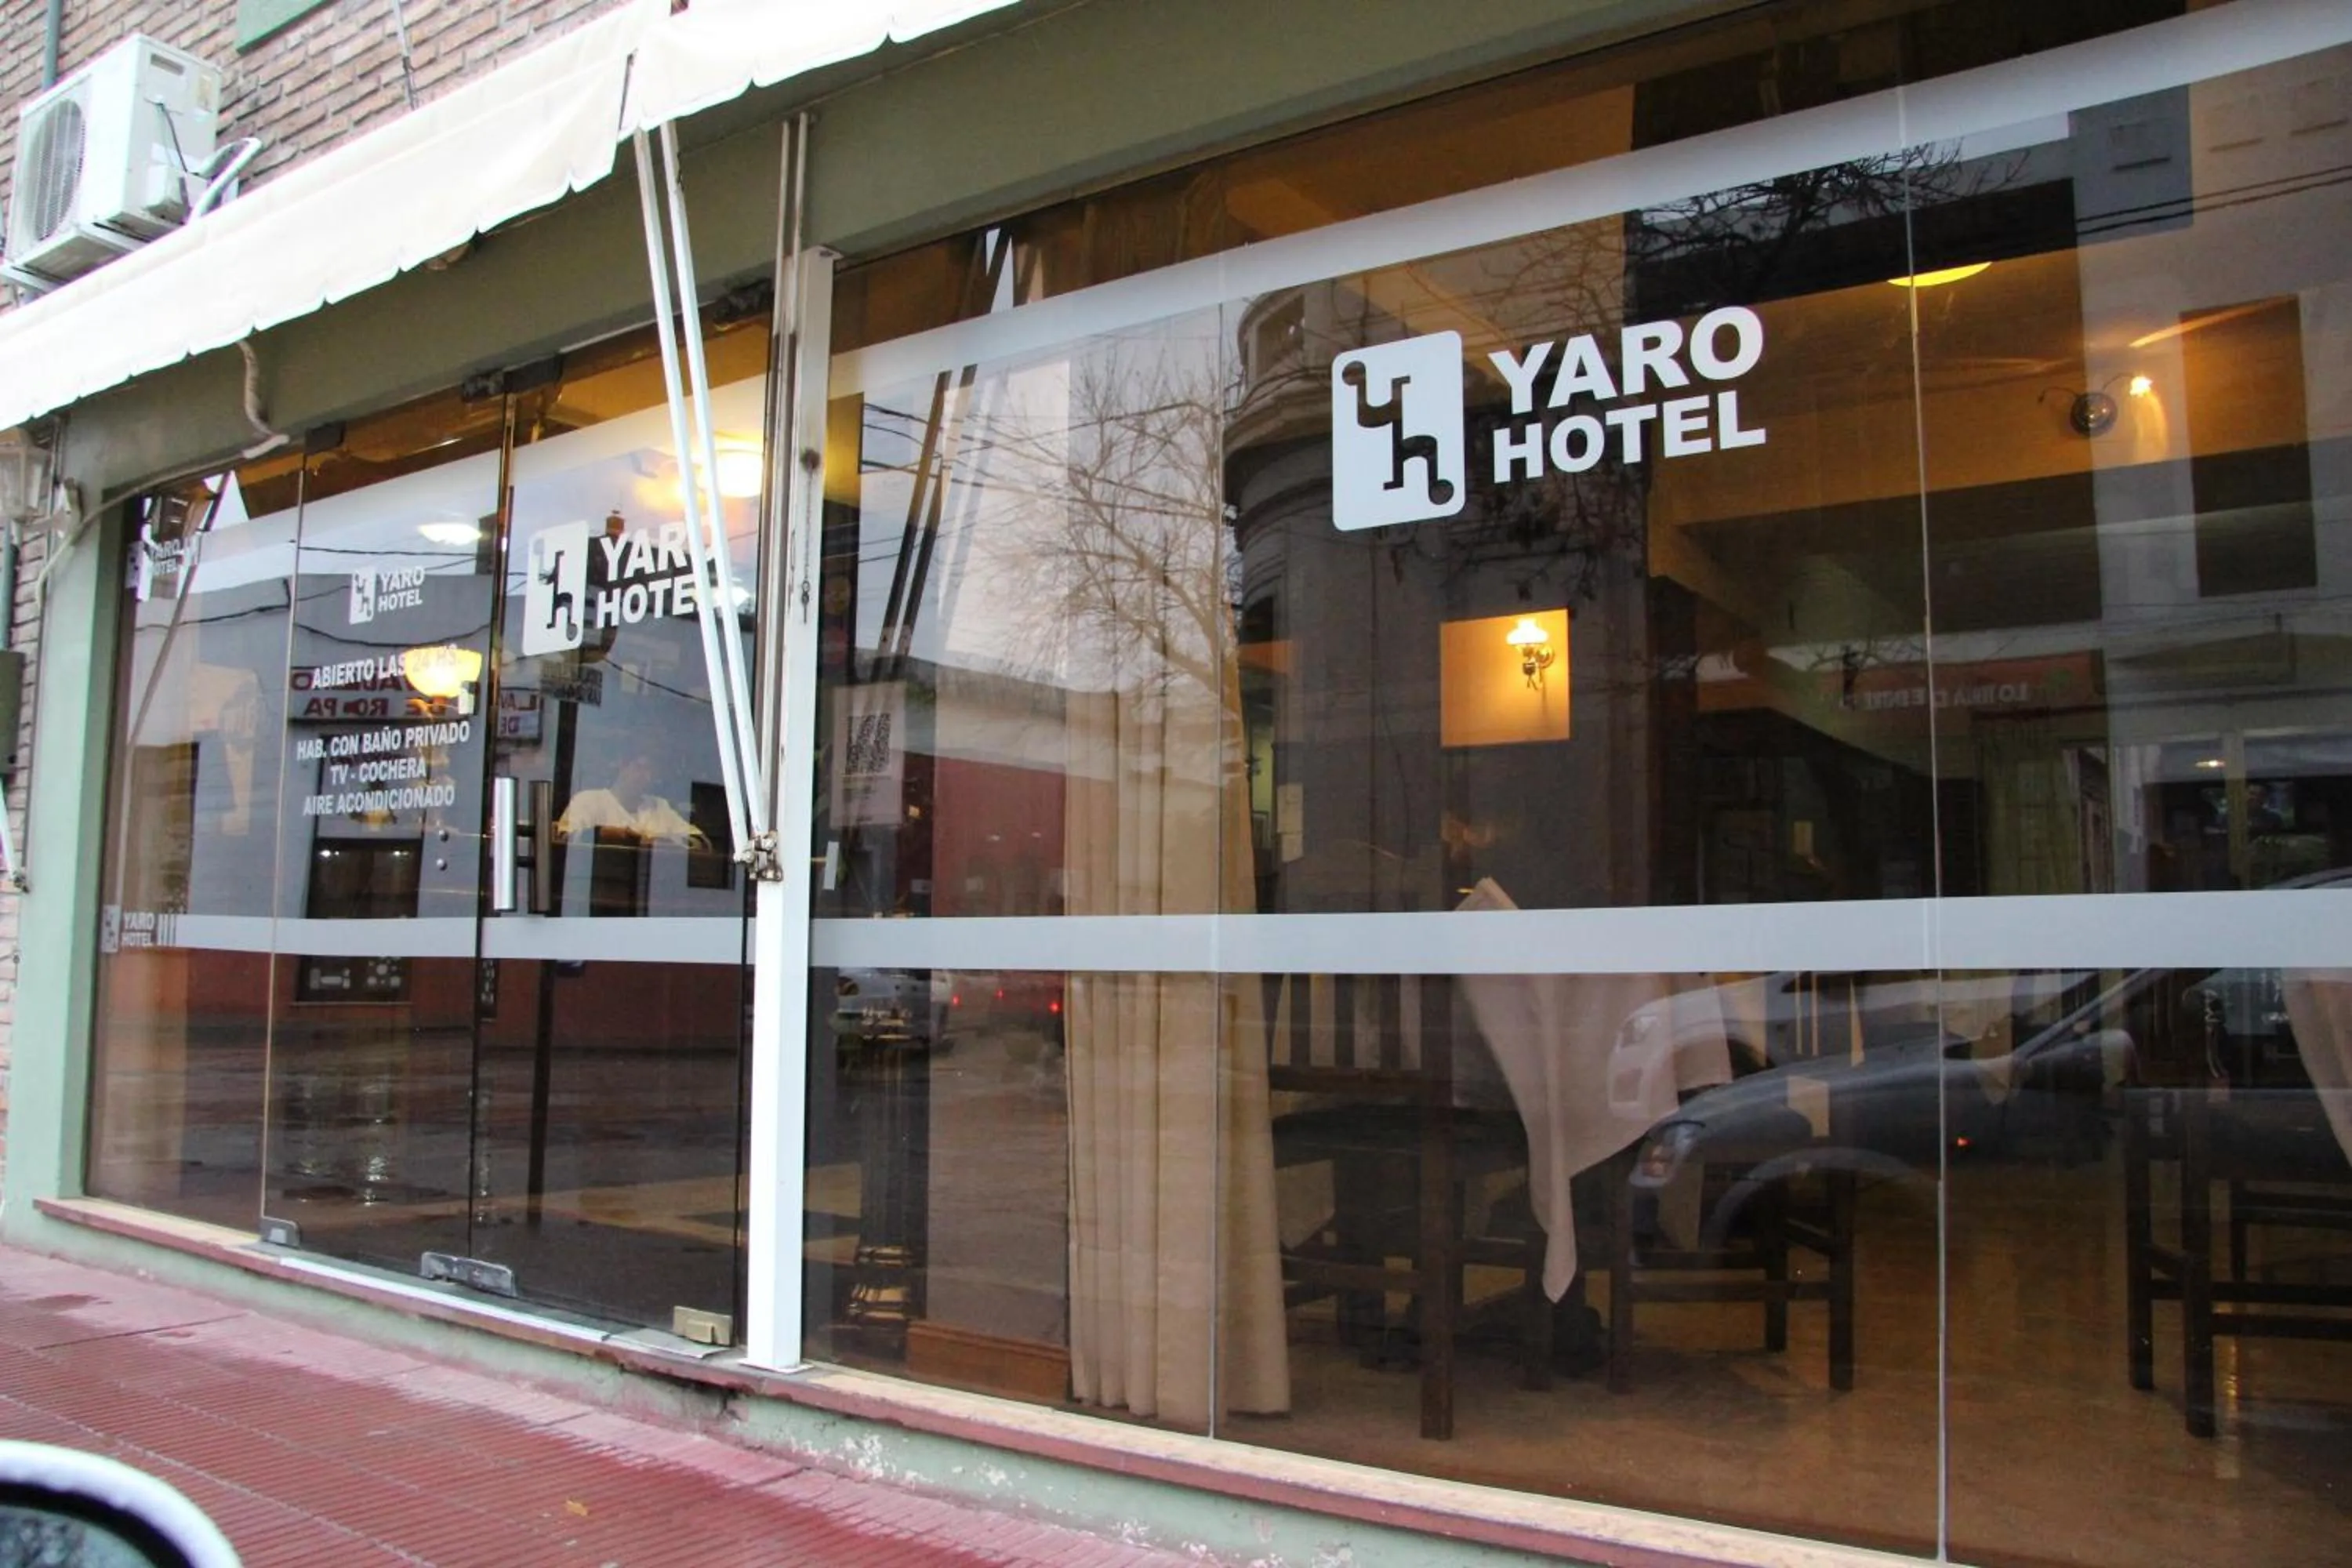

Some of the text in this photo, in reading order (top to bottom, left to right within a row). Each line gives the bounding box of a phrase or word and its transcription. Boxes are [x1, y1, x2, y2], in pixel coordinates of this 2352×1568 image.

[1488, 306, 1764, 415] YARO
[1493, 390, 1766, 484] HOTEL
[379, 565, 425, 593] YARO
[378, 589, 423, 612] HOTEL
[597, 572, 723, 630] HOTE
[313, 656, 375, 689] ABIERTO
[379, 652, 406, 679] LAS
[296, 721, 470, 760] HAB. CON BAÑO PRIVADO
[330, 764, 350, 785] TV
[359, 757, 427, 783] COCHERA
[303, 785, 456, 816] AIRE ACONDICIONADO
